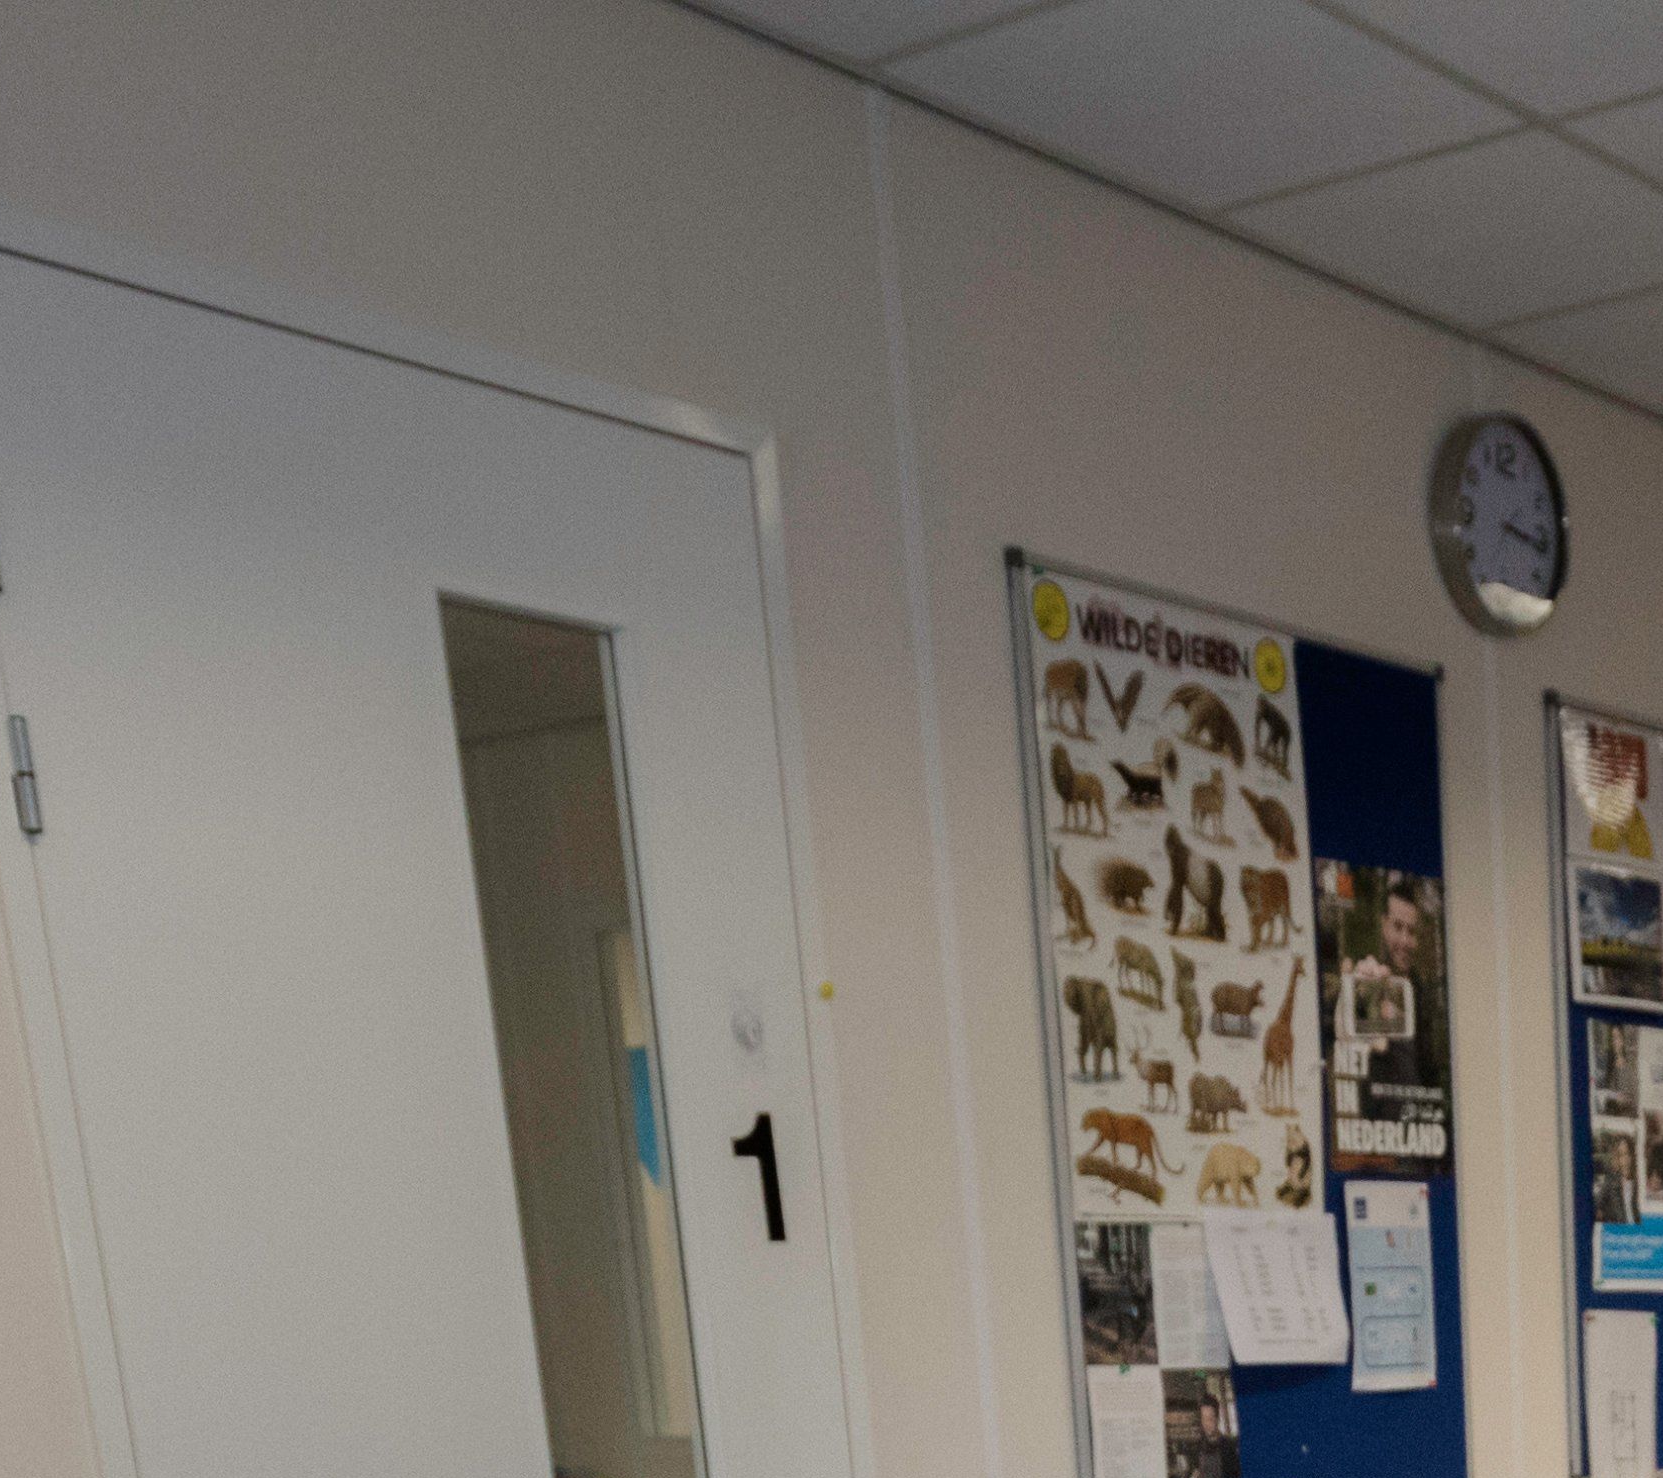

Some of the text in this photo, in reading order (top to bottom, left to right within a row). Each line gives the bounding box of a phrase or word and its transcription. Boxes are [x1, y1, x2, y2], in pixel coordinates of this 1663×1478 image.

[1075, 602, 1251, 679] WILDE DIEREN
[1335, 1080, 1360, 1114] IN
[1336, 1118, 1447, 1158] NEDERLAND
